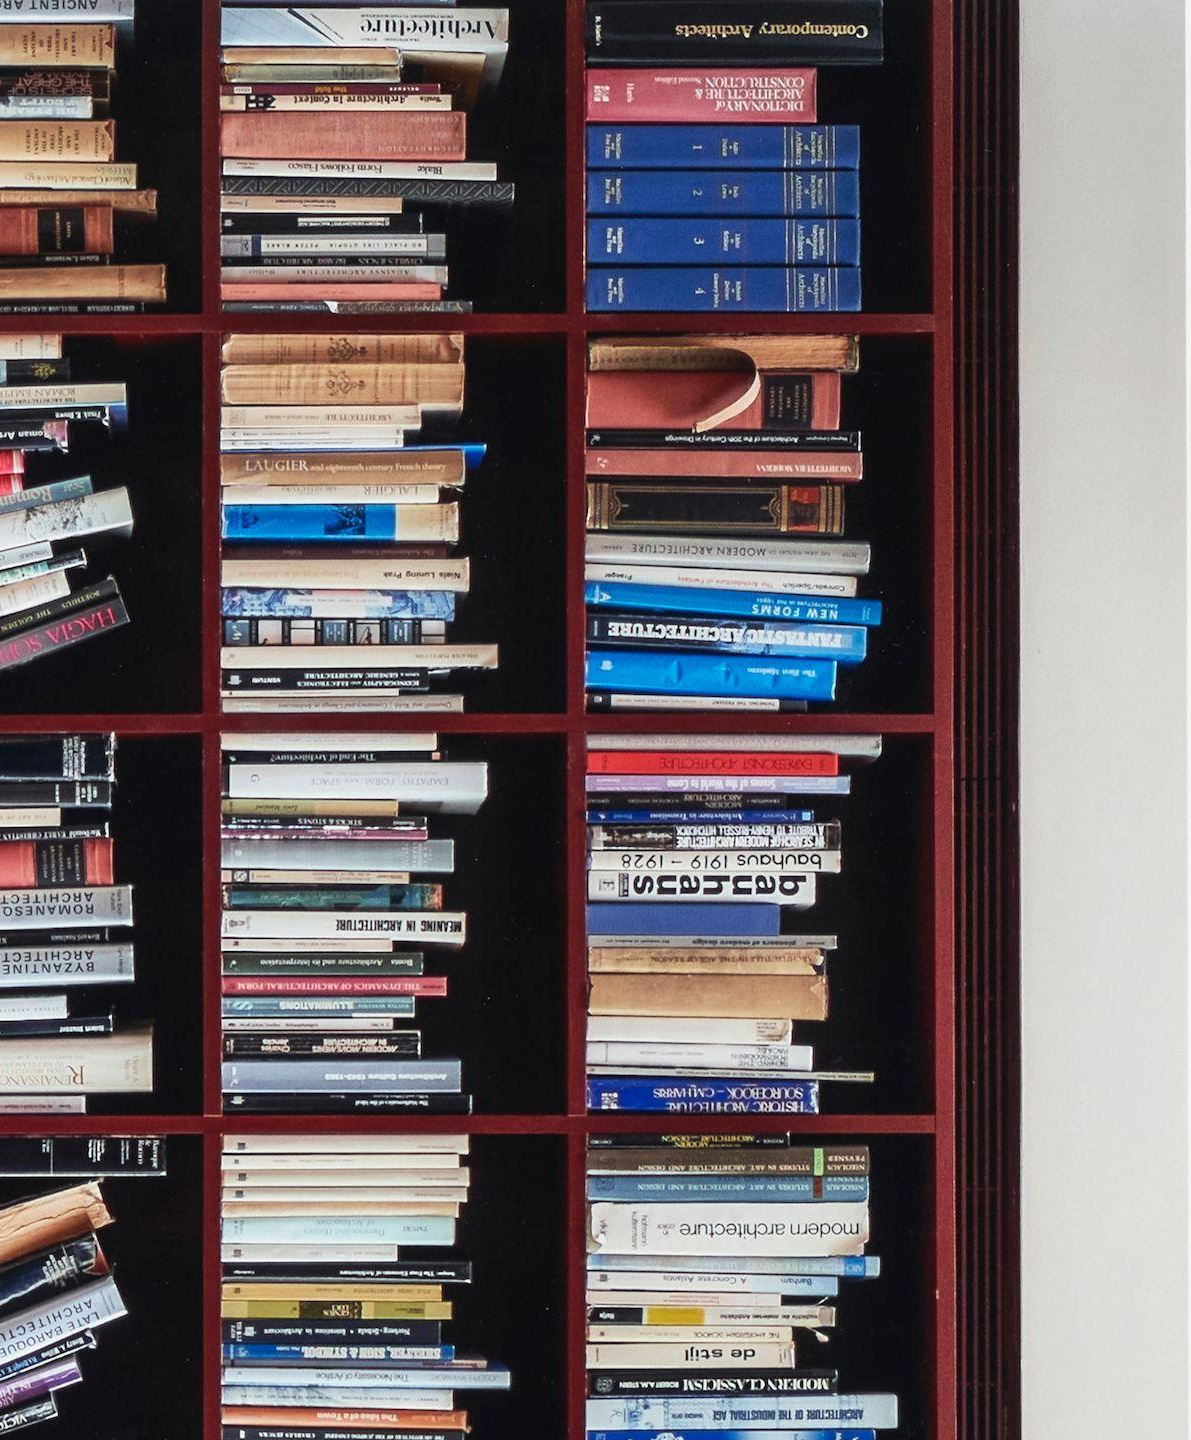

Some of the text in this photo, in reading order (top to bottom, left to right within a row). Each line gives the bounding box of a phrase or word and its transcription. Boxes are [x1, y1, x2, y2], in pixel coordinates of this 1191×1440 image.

[27, 0, 98, 10] ANCIENT
[360, 19, 499, 39] Architecture
[675, 22, 868, 39] Contemporary Architects
[705, 77, 804, 87] CONSTRUCTION
[695, 89, 804, 100] ARCHITECTURE &
[715, 100, 803, 111] DICTIONARY of
[288, 163, 442, 175] Blake Form Follows Fiasco
[245, 460, 308, 471] LAUGIER
[383, 570, 460, 579] Niels Luning Prak
[752, 604, 838, 620] NEW FORMS
[45, 606, 116, 643] HAGIA
[622, 854, 821, 869] bauhaus 1919 1928
[634, 876, 806, 898] bauhaus
[336, 919, 461, 933] MEANING IN ARCHITECTURE
[2, 963, 94, 974] BYZANTINE
[680, 1223, 860, 1239] modern architecture
[65, 1311, 100, 1331] LATE
[685, 1347, 756, 1362] de stijl
[683, 1378, 829, 1391] MODERN CLASSICISM
